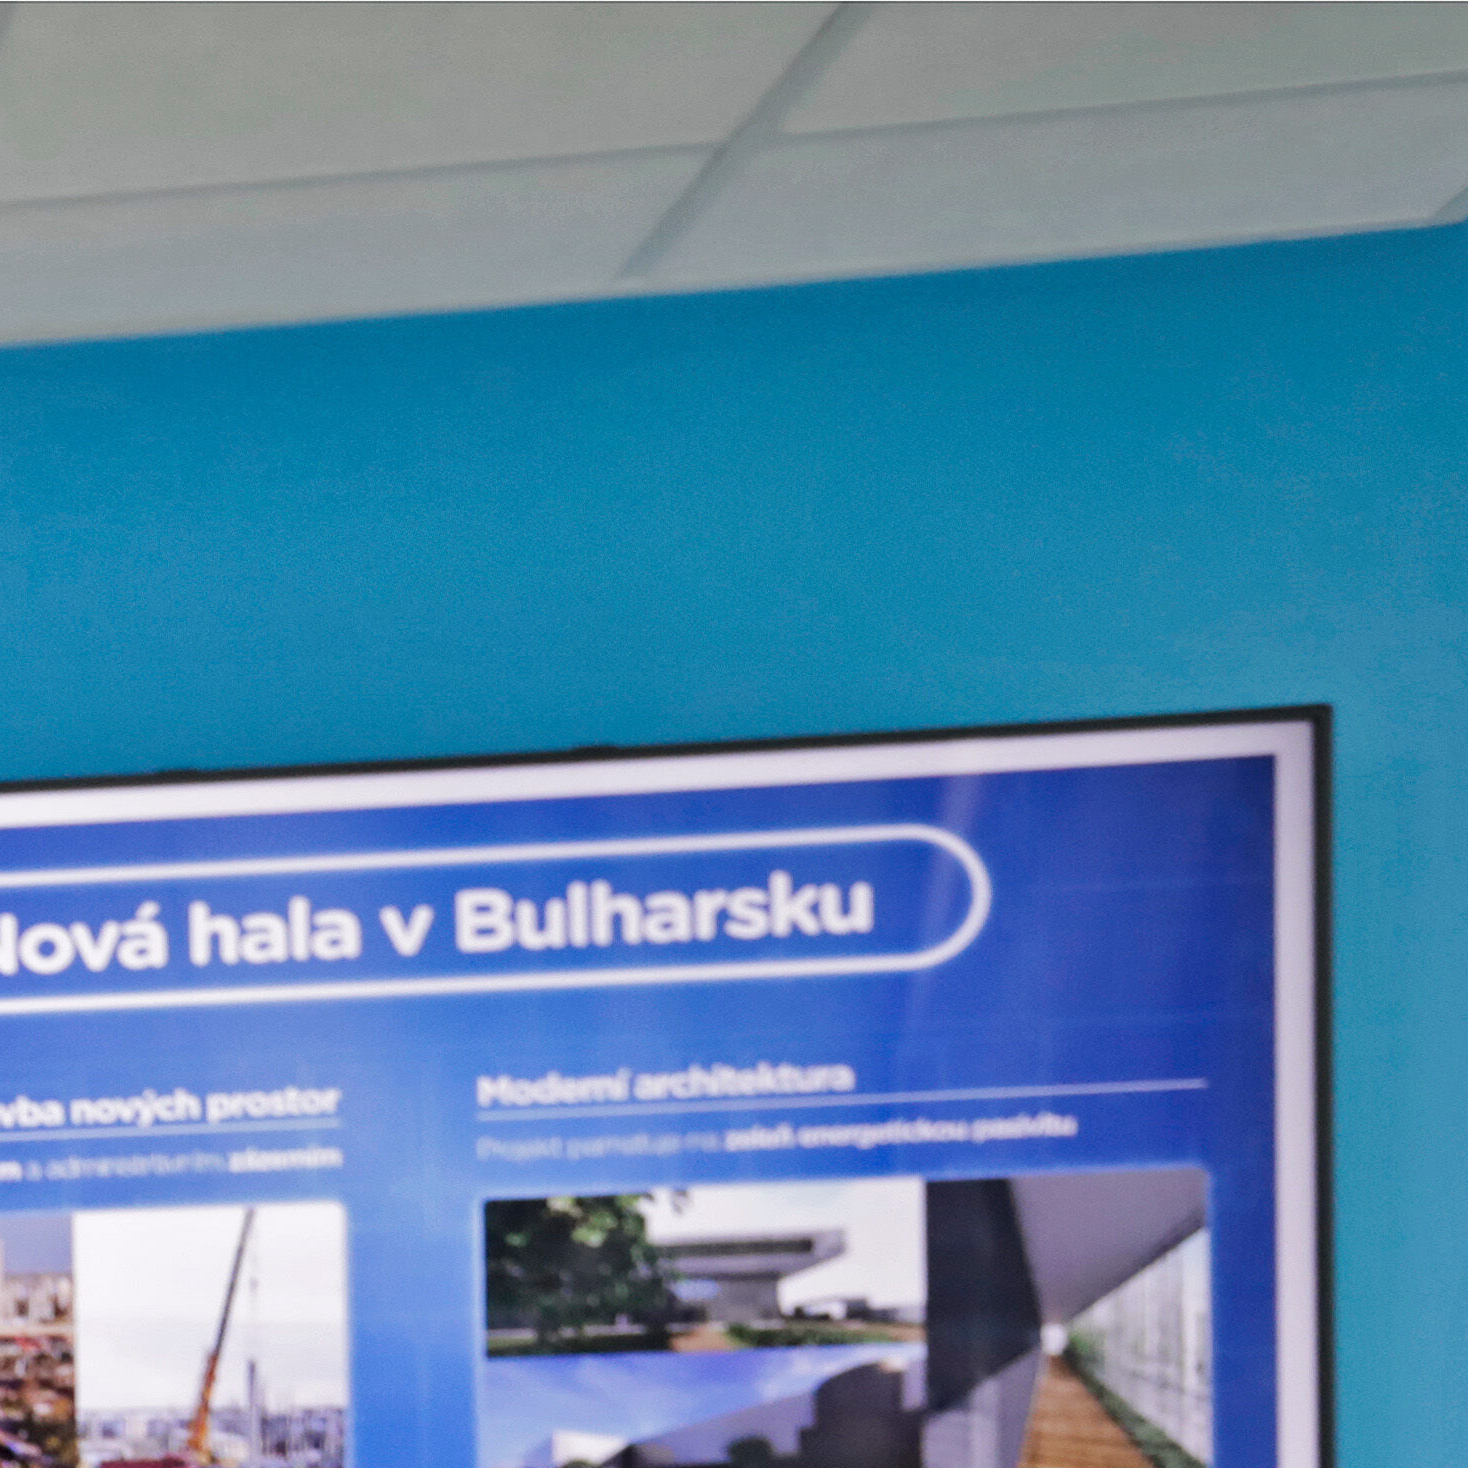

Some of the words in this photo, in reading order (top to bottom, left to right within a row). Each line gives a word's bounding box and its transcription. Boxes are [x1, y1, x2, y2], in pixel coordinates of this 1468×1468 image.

[189, 897, 362, 966] hala
[380, 904, 435, 957] v
[454, 870, 876, 953] Bulharsku
[70, 1087, 201, 1128] nových
[206, 1086, 341, 1124] prostor
[477, 1067, 632, 1107] Moderní
[634, 1062, 856, 1099] architektura
